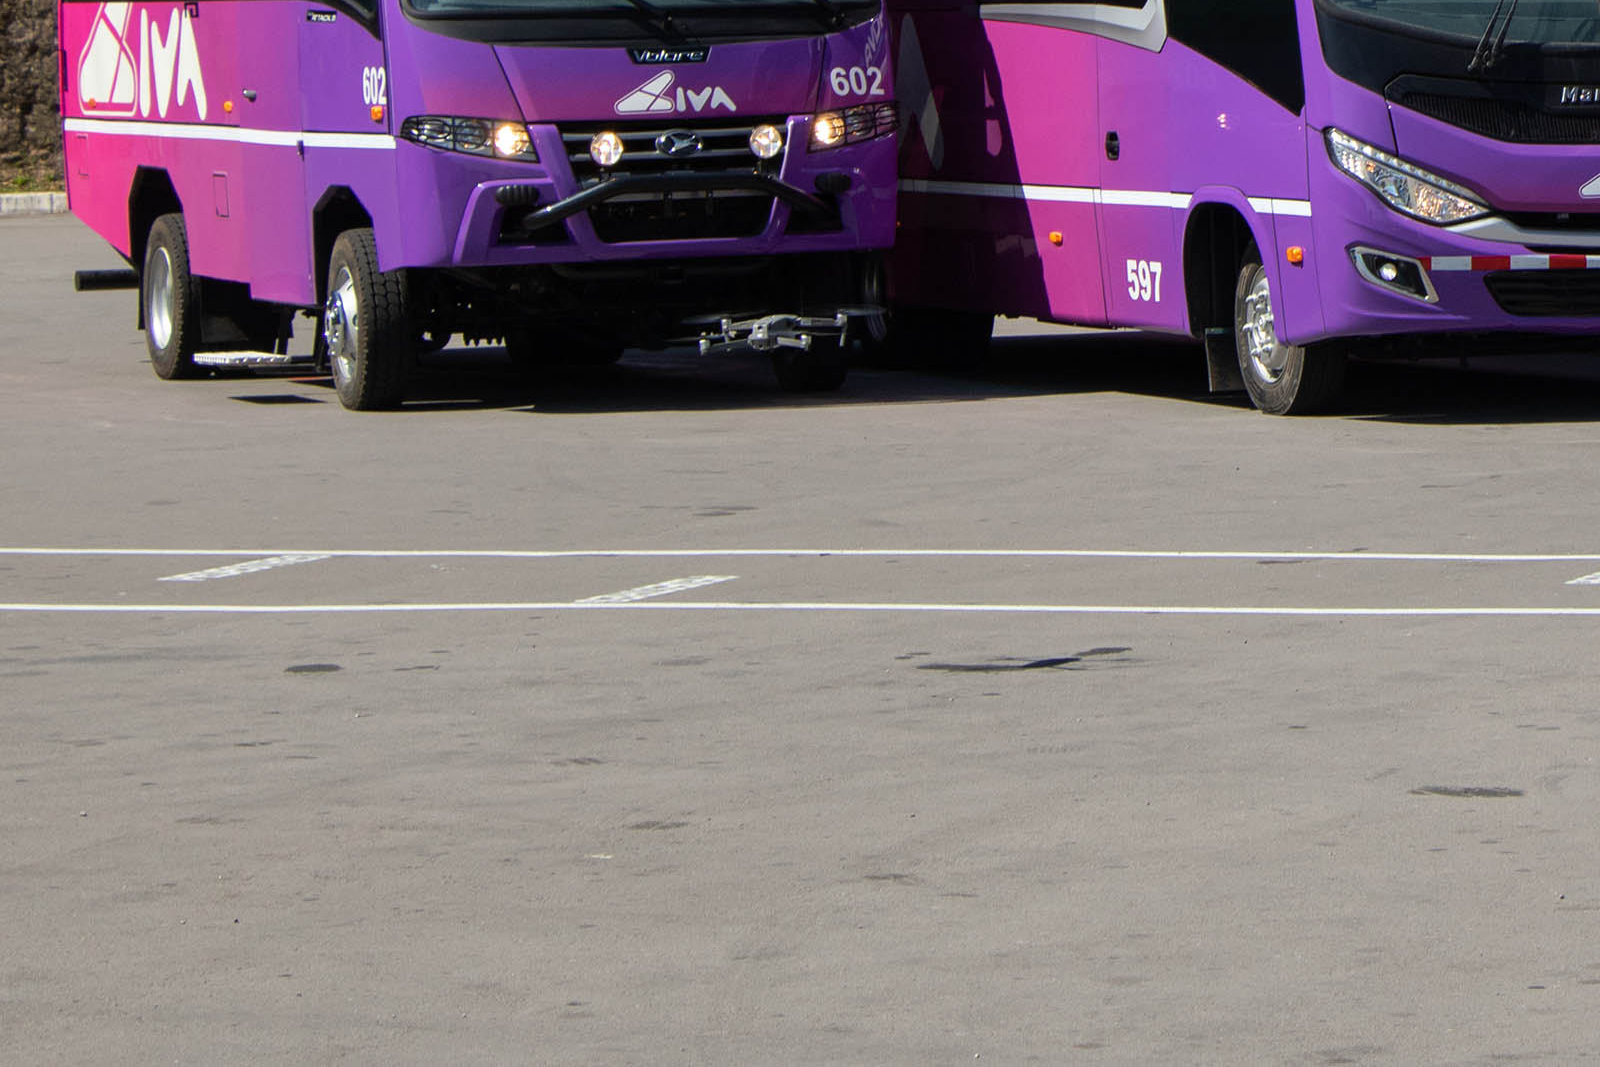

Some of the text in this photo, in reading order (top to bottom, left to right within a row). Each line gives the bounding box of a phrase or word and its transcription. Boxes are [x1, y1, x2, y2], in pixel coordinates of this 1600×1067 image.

[362, 66, 387, 105] 602
[829, 65, 885, 97] 602
[1126, 258, 1162, 302] 597
